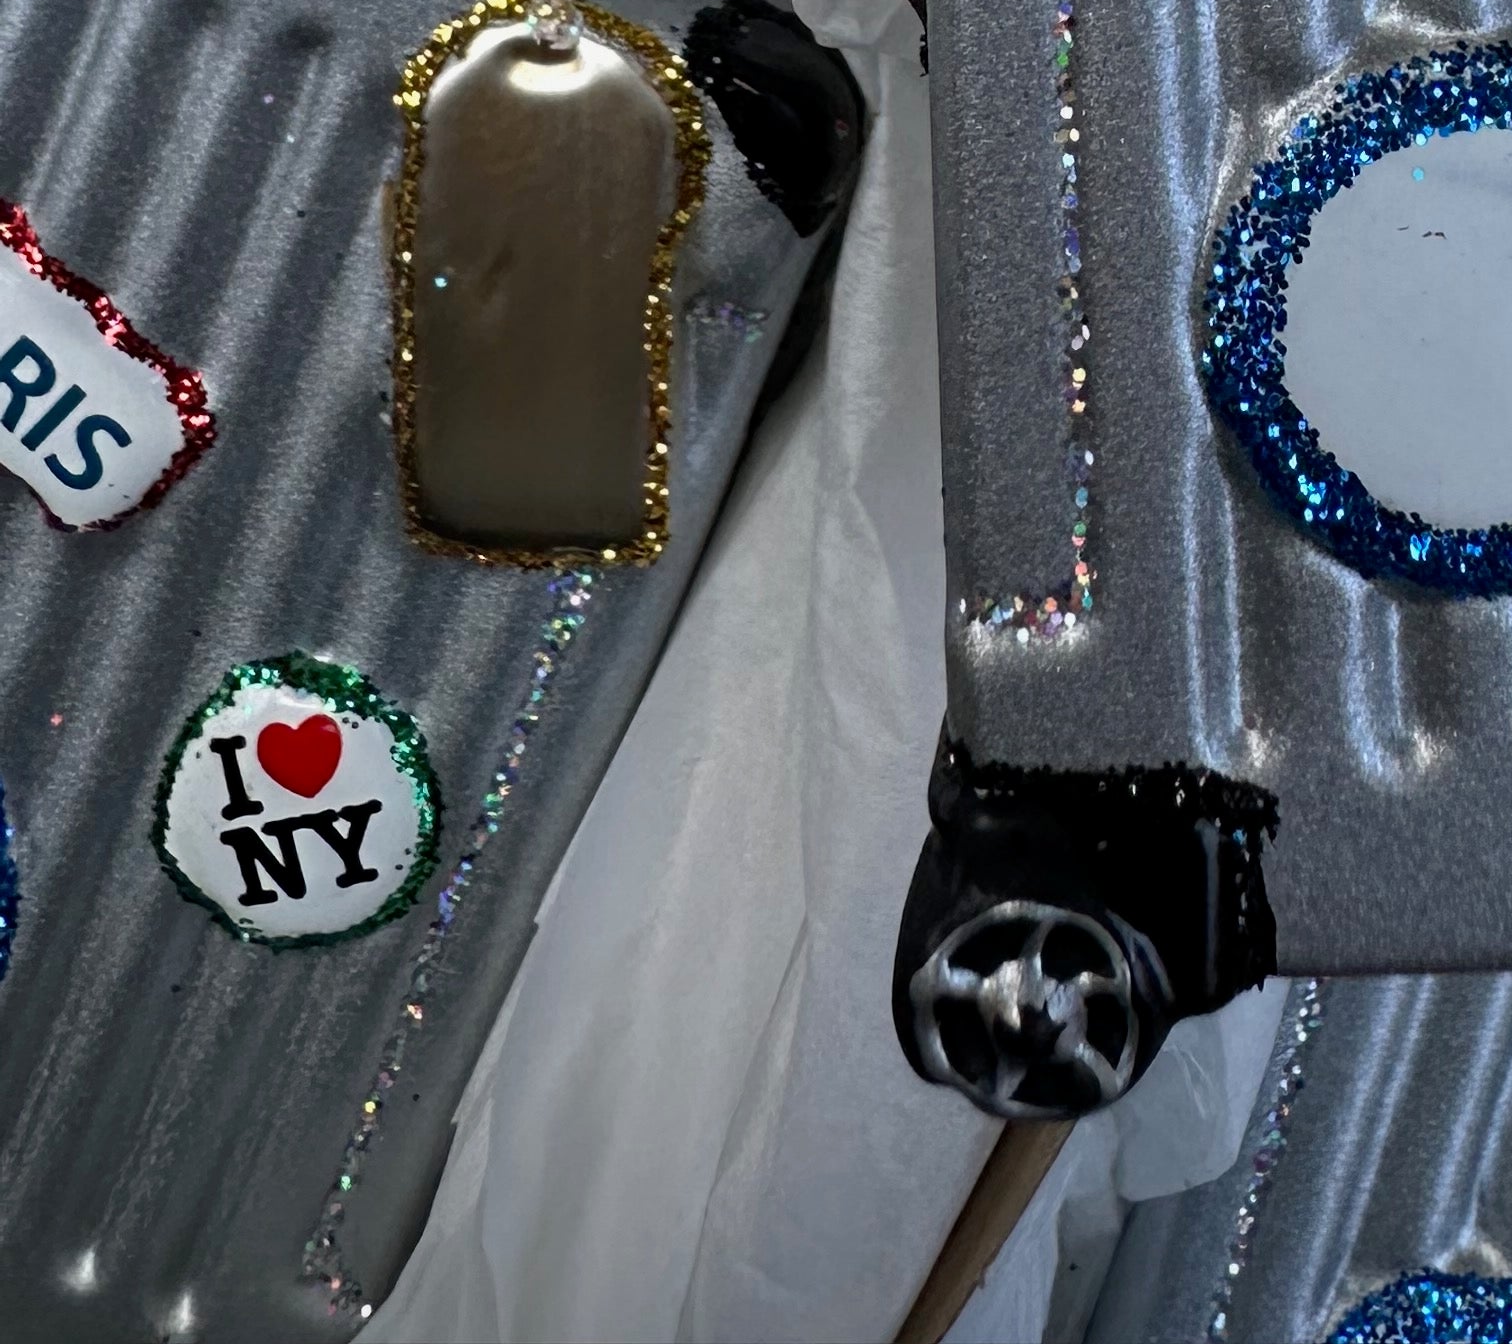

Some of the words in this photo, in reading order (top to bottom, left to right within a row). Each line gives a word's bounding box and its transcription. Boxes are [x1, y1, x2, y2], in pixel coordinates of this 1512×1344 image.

[0, 335, 132, 490] RIS
[209, 735, 264, 820] I
[220, 799, 382, 907] NY
